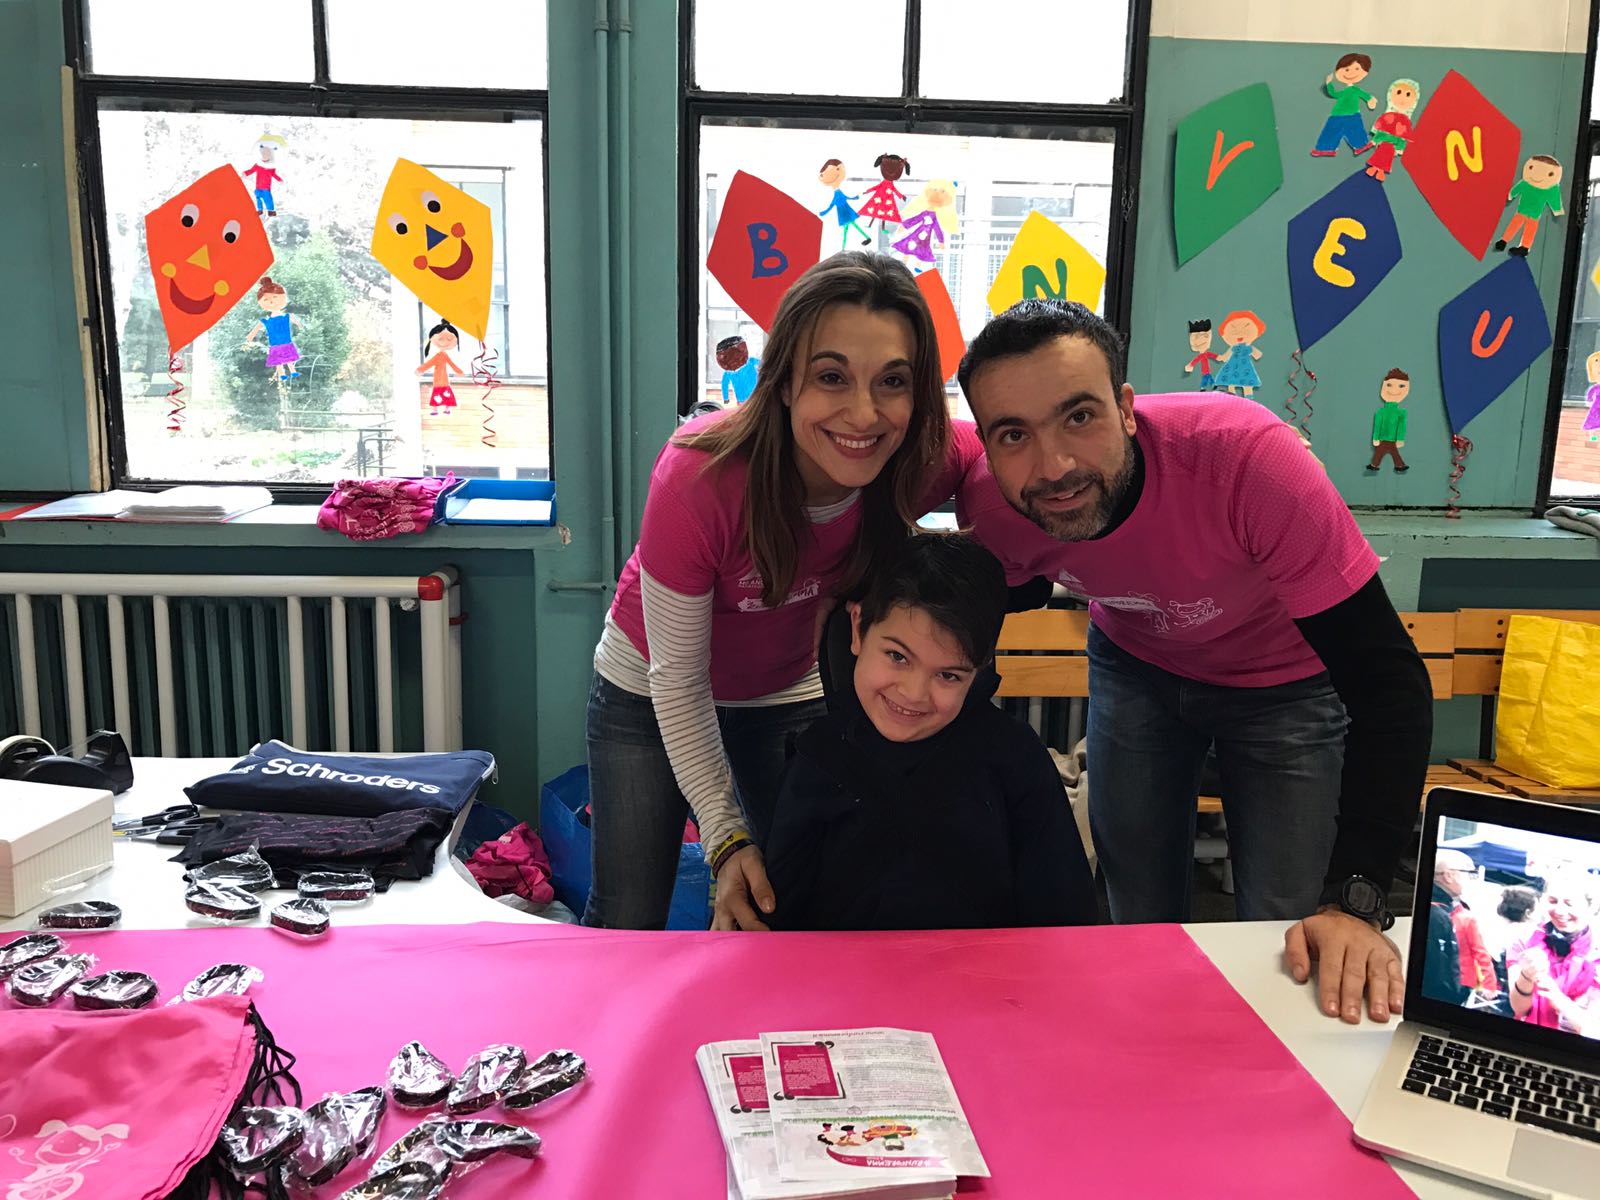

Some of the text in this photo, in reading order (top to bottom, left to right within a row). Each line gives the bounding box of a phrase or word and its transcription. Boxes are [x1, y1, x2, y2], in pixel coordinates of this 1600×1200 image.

[1446, 126, 1483, 181] N
[746, 222, 788, 279] B
[1313, 217, 1366, 287] E
[1022, 257, 1067, 300] N
[1471, 309, 1513, 358] U
[261, 757, 441, 794] Schroders
